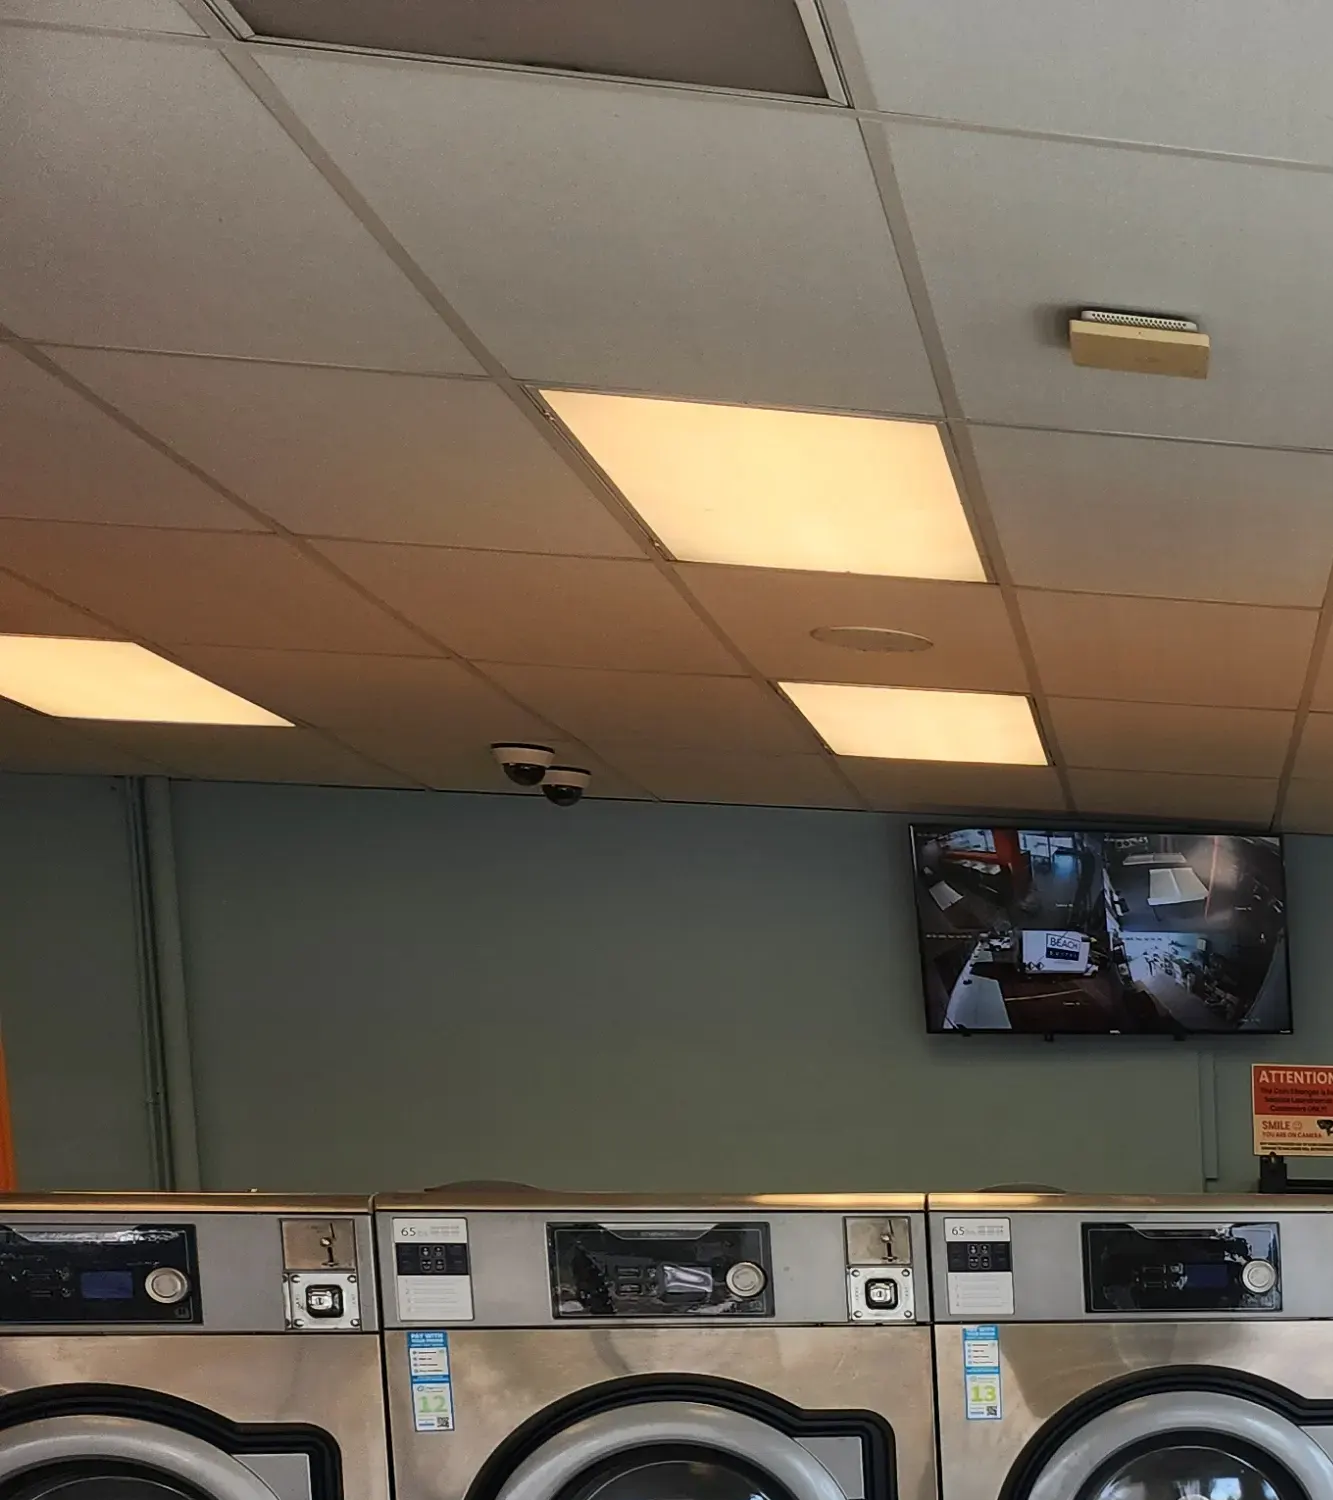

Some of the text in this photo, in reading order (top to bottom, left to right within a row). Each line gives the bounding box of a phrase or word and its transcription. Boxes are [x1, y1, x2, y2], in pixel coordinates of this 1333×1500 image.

[1050, 937, 1078, 949] BEACH
[1262, 1120, 1290, 1130] SMILE
[401, 1227, 416, 1236] 65
[952, 1226, 965, 1236] 65
[971, 1386, 996, 1402] 13
[418, 1395, 448, 1413] 12
